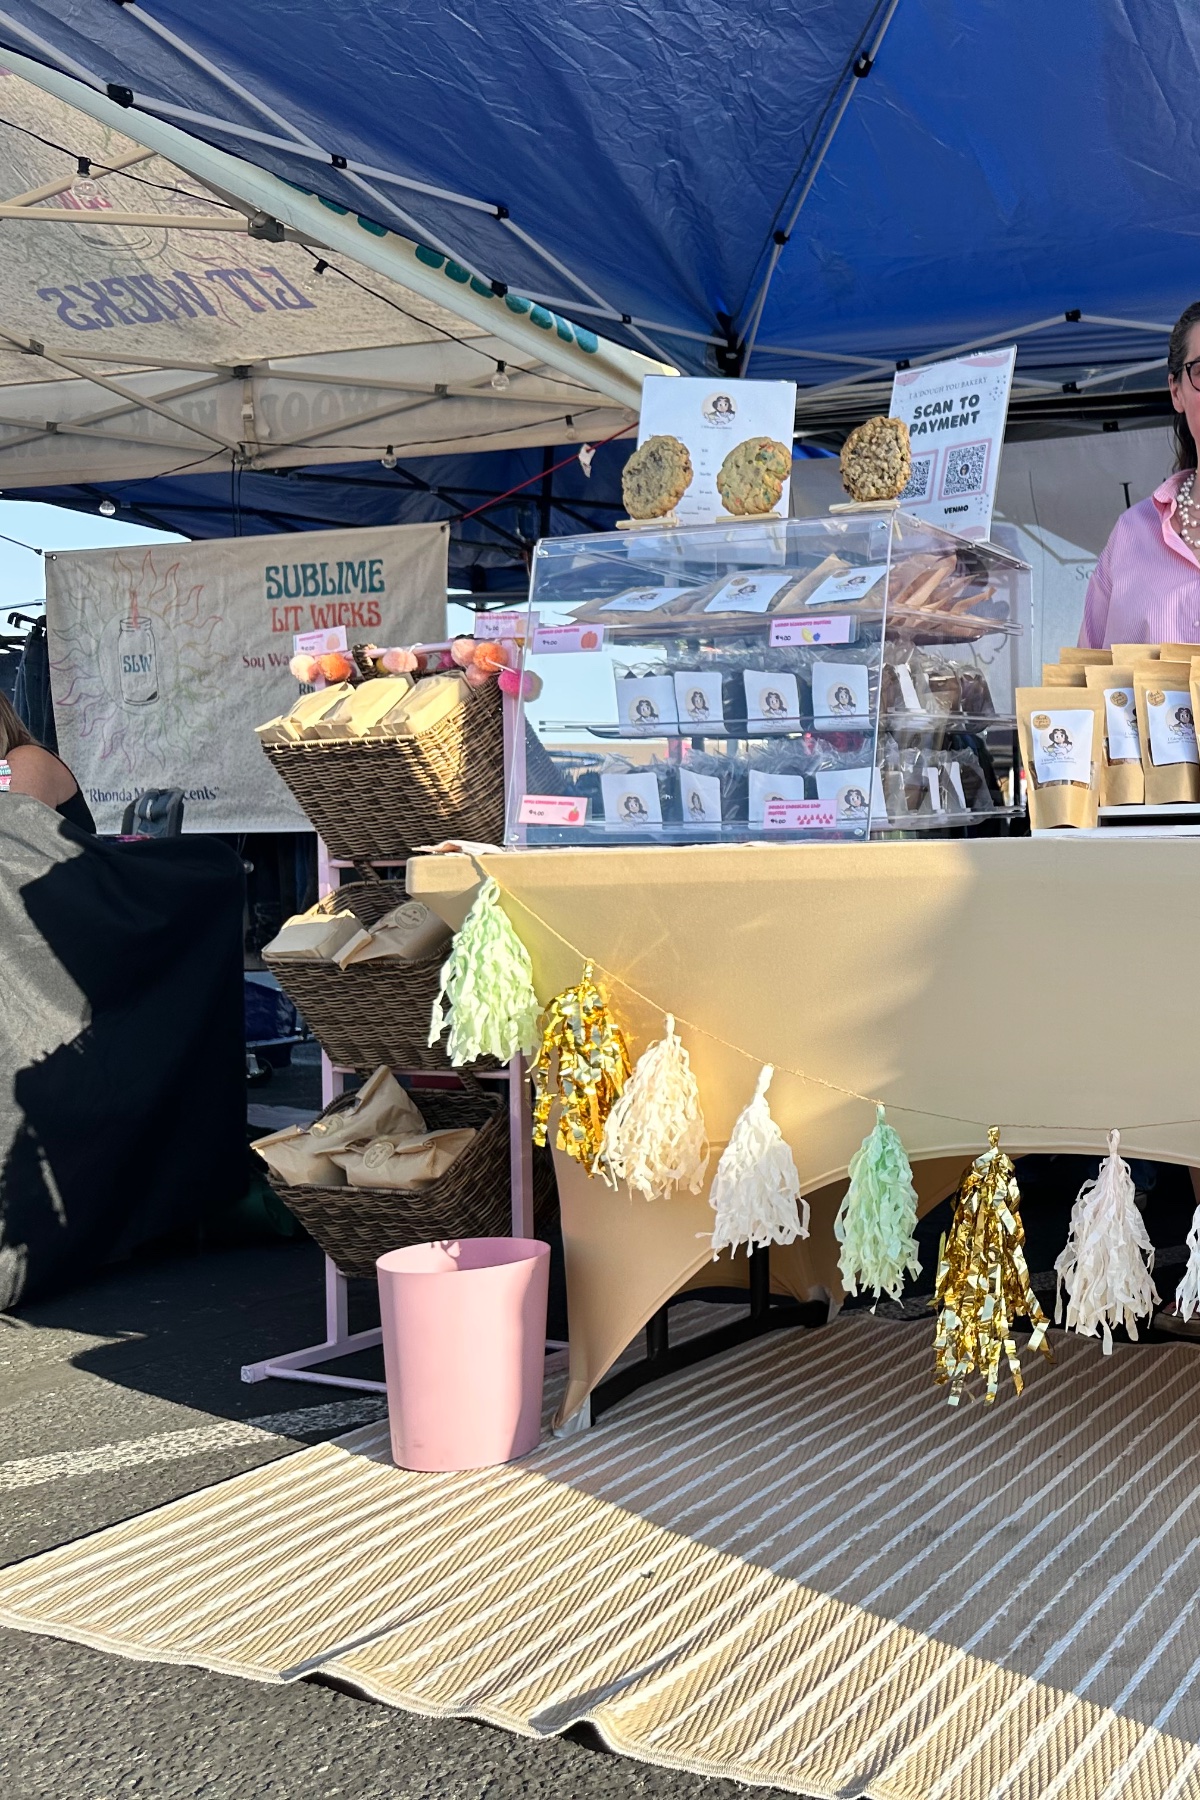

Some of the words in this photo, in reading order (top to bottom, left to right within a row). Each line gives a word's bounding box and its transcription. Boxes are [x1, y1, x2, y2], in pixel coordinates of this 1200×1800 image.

[945, 382, 960, 392] YOU
[961, 376, 988, 388] BAKERY
[913, 399, 953, 420] SCAN
[959, 394, 980, 409] TO
[909, 410, 980, 438] PAYMENT
[944, 504, 969, 514] VENMO
[265, 559, 386, 599] SUBLIME
[272, 605, 304, 632] LIT
[310, 600, 382, 631] WICKS
[122, 654, 152, 673] SLW
[243, 655, 266, 670] Soy
[268, 653, 294, 667] Wa
